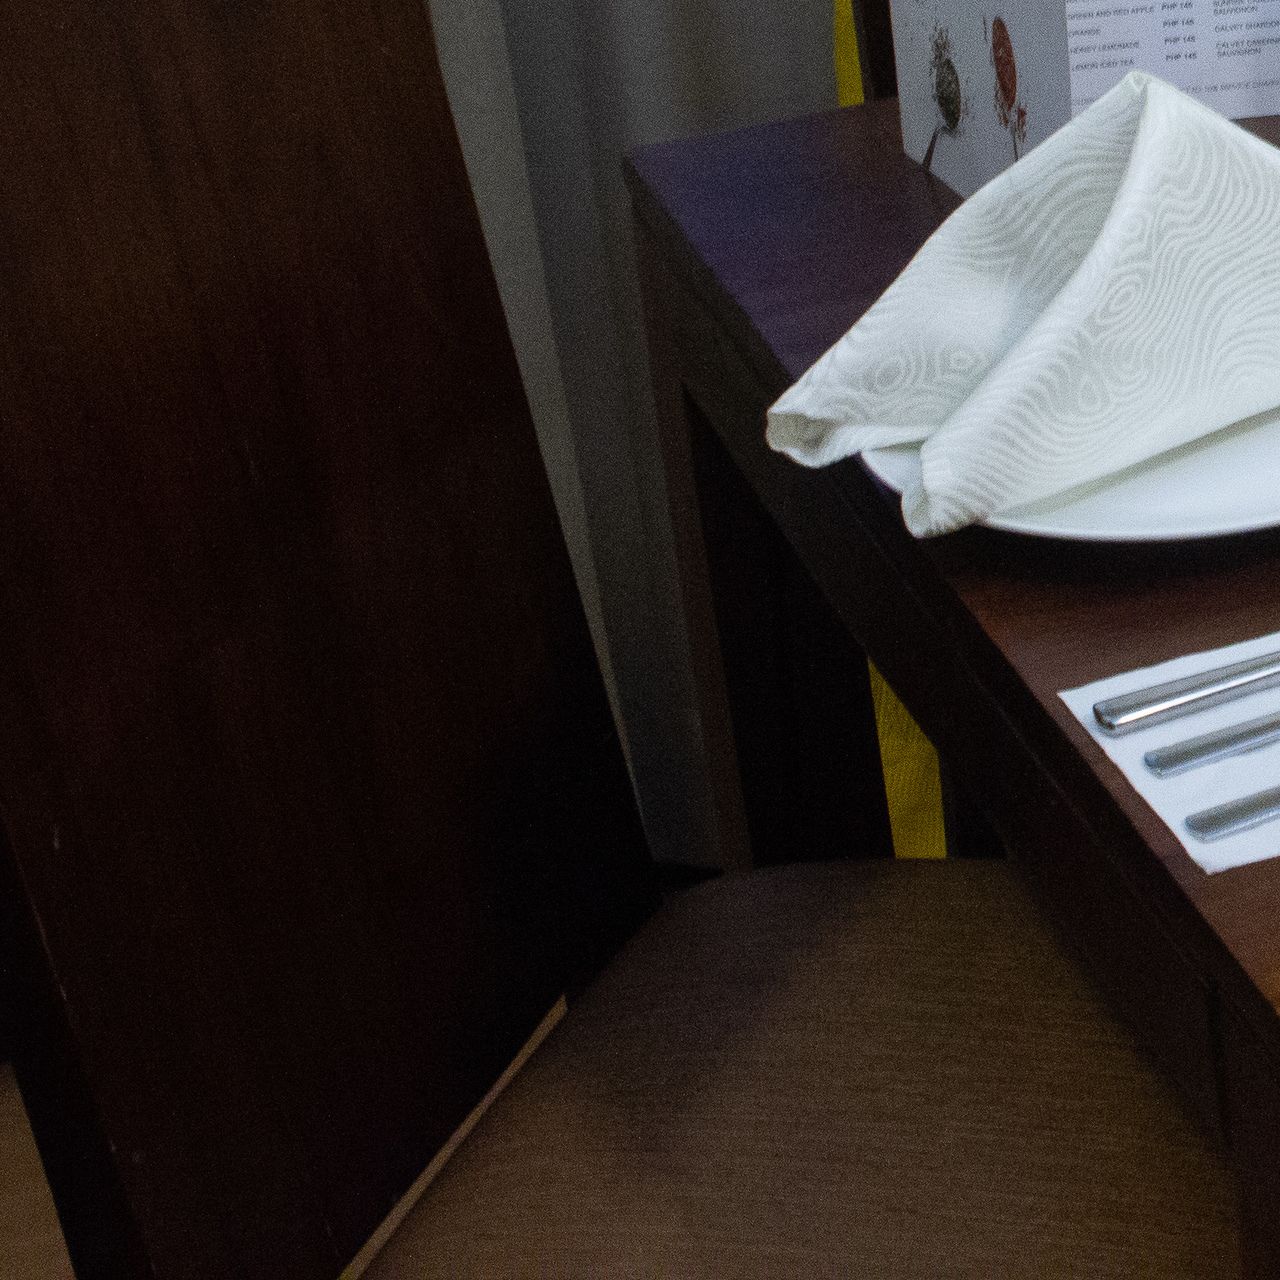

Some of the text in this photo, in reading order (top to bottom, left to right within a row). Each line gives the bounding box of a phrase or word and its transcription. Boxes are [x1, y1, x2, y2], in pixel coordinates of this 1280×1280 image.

[1161, 2, 1177, 11] PHP
[1180, 1, 1194, 10] 145
[1163, 19, 1179, 28] PHP
[1182, 18, 1196, 26] 145
[1164, 36, 1180, 45] PHP
[1182, 35, 1196, 44] 145
[1120, 56, 1134, 66] TEA
[1166, 53, 1182, 62] PHP
[1184, 52, 1198, 60] 145
